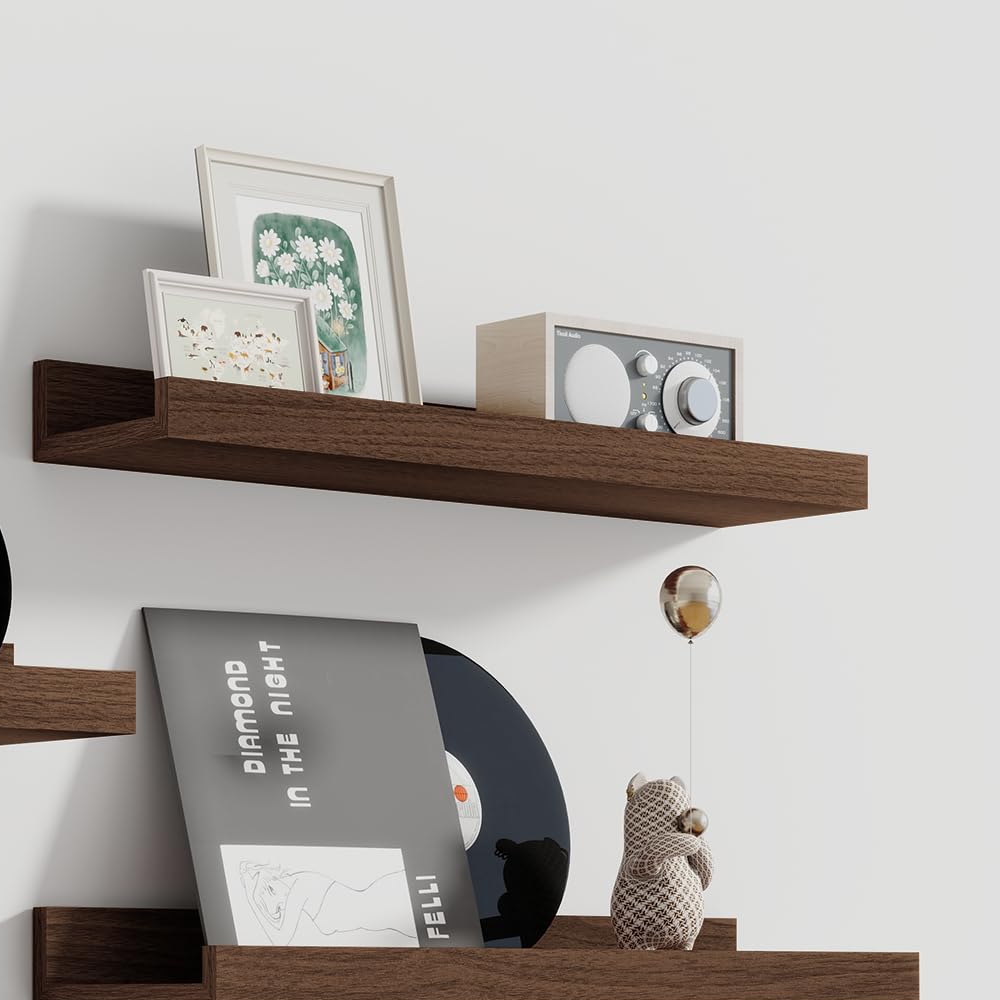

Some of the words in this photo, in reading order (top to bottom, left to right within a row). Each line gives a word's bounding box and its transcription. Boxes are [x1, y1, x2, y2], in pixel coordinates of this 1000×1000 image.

[258, 640, 293, 716] NIGHT
[225, 659, 266, 774] DIAMOND
[275, 732, 304, 775] THE
[416, 874, 450, 940] FELLI
